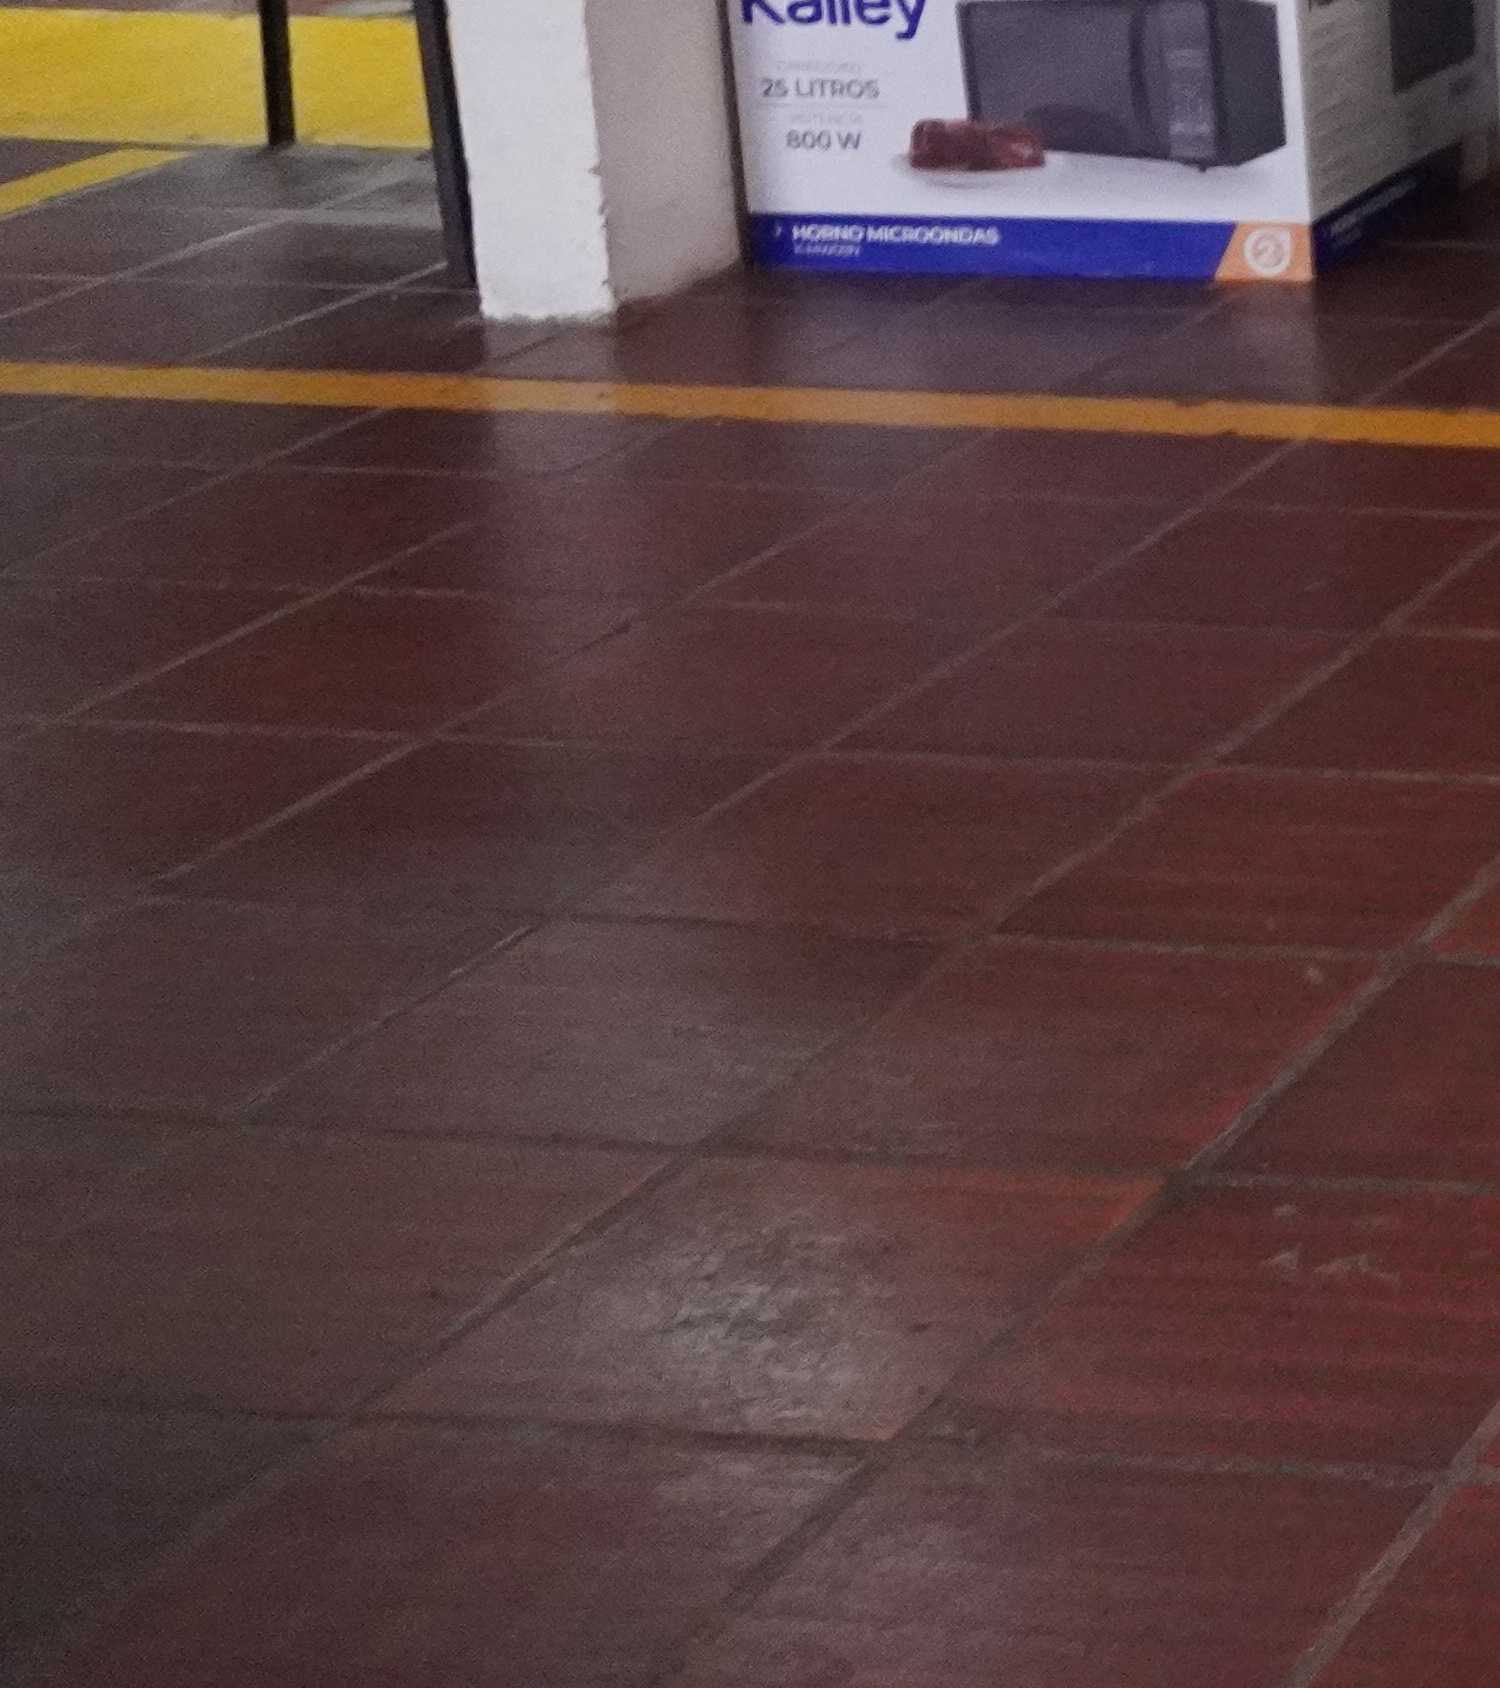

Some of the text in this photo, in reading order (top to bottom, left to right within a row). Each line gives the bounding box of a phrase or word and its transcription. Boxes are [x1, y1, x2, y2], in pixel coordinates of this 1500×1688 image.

[762, 79, 879, 99] 25 LITROS
[787, 129, 861, 150] 800 W
[792, 223, 999, 245] HORNO MICROONDAS
